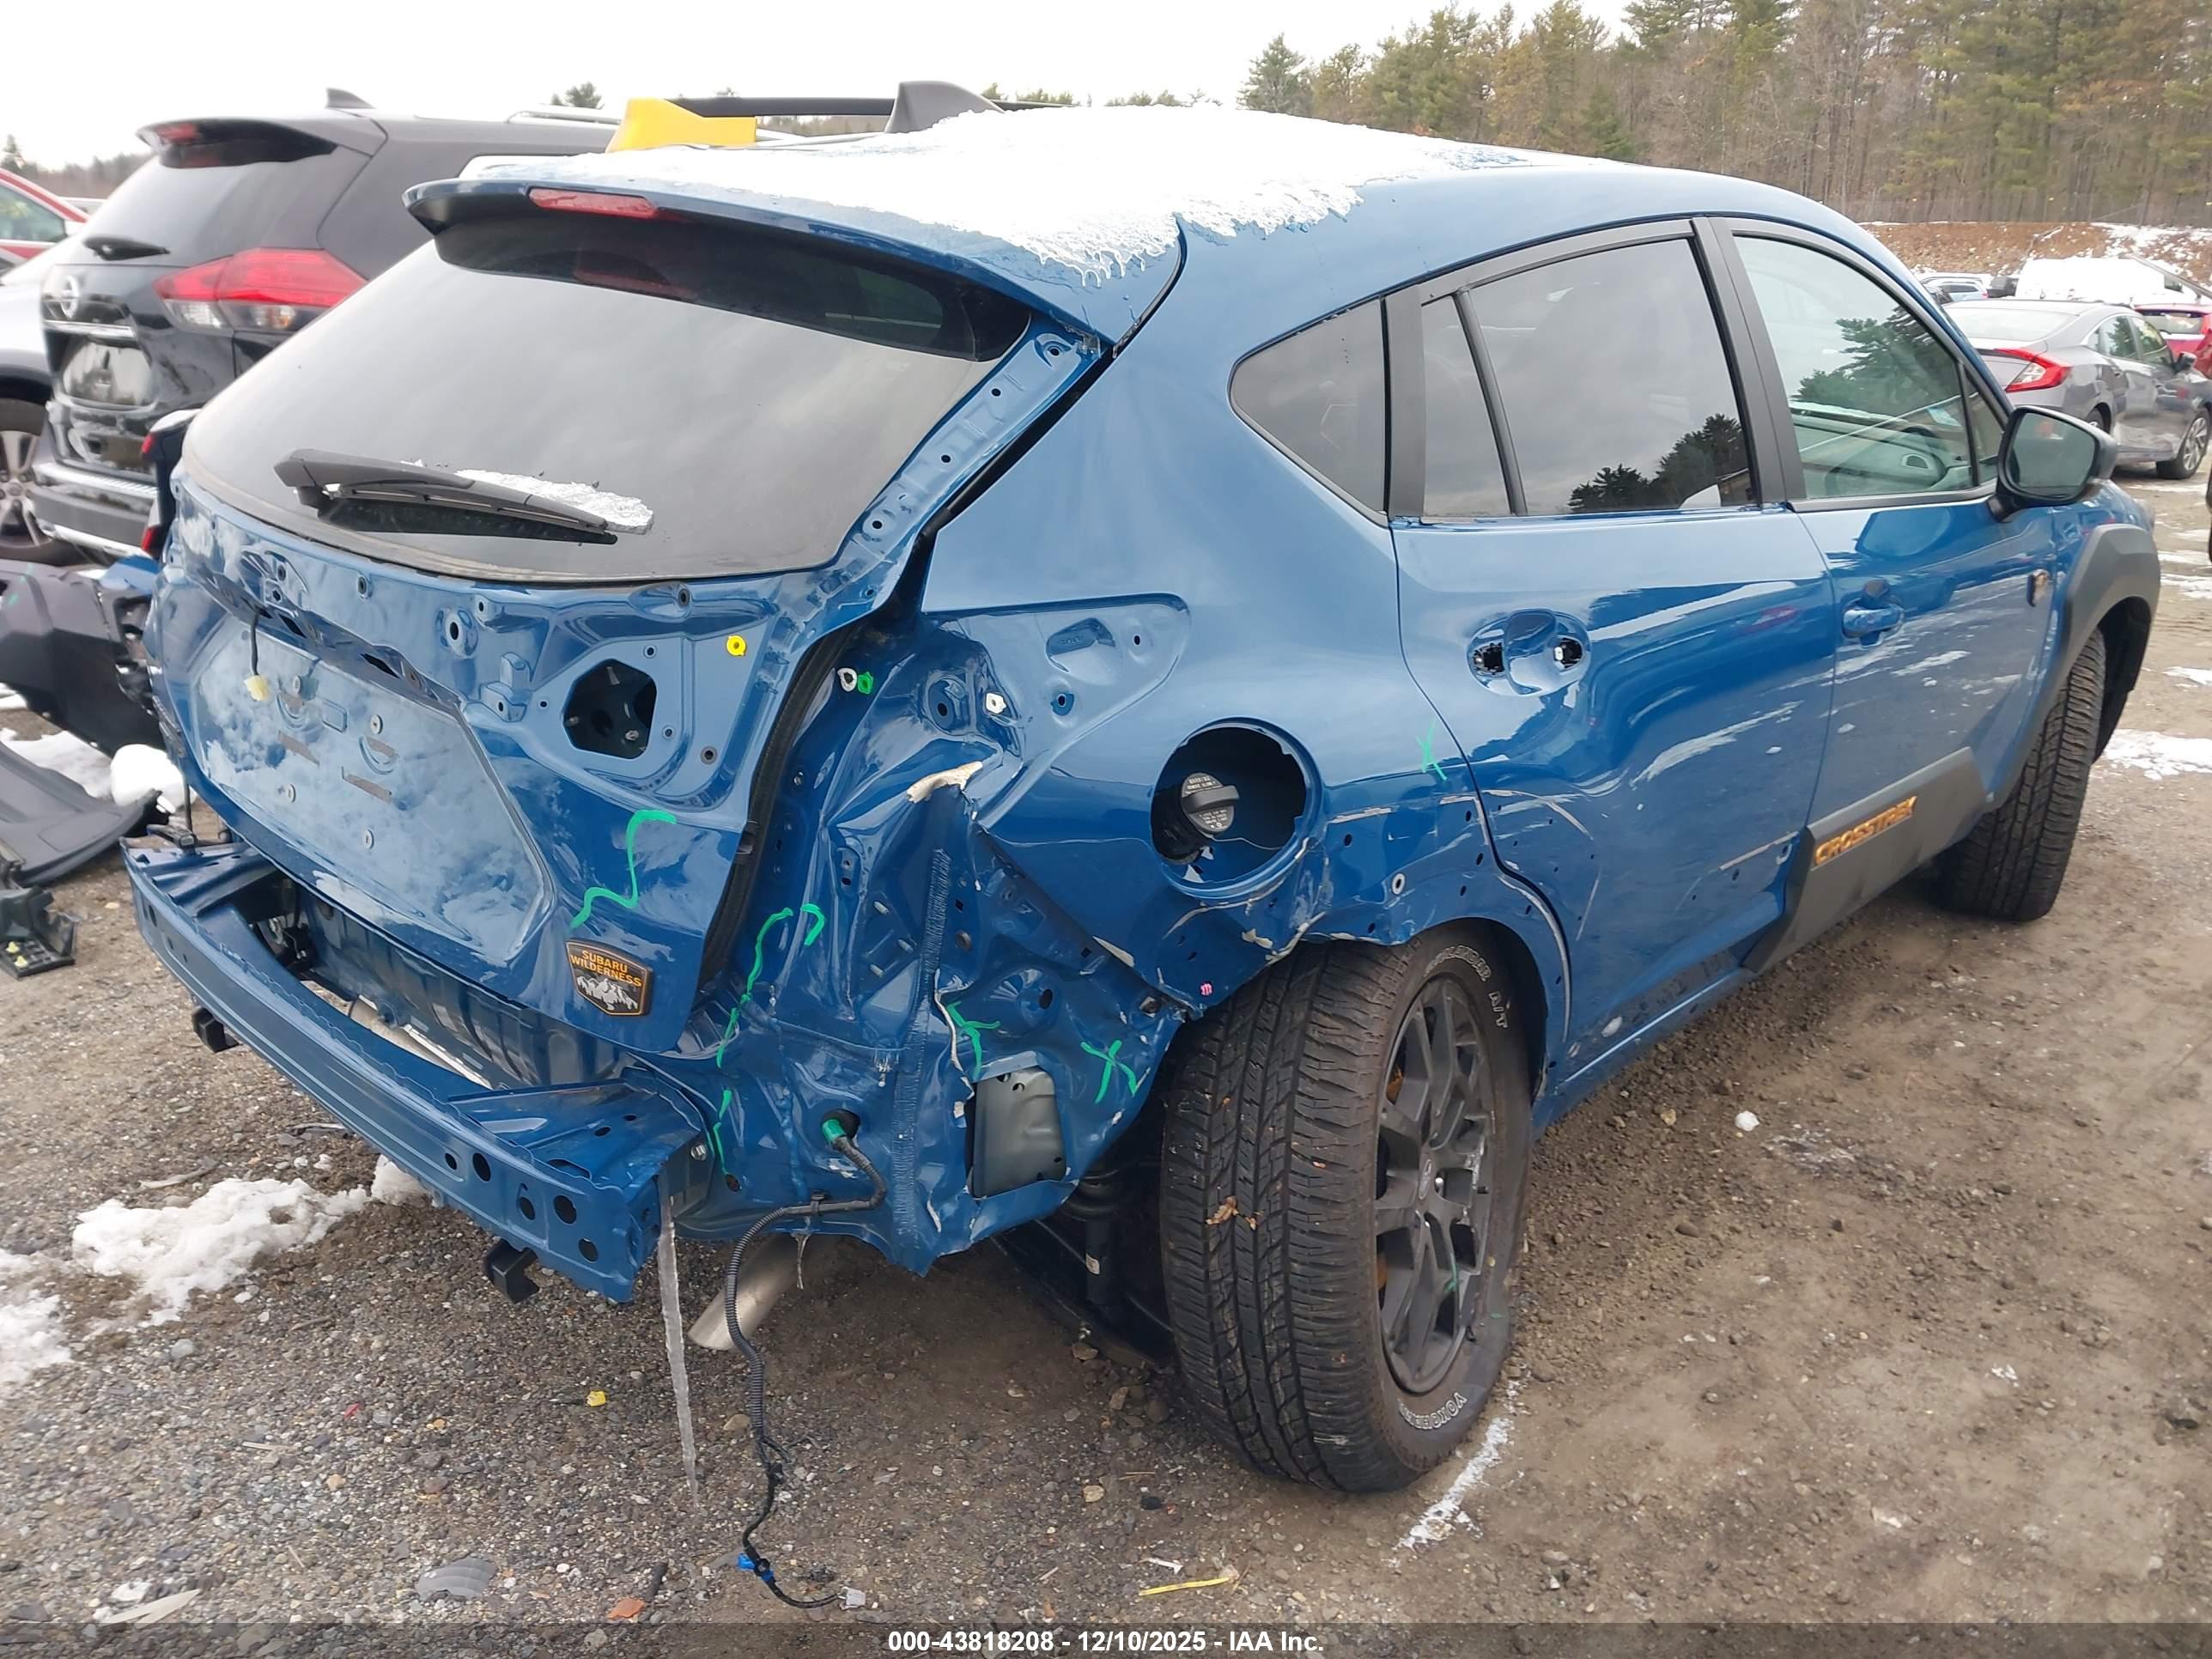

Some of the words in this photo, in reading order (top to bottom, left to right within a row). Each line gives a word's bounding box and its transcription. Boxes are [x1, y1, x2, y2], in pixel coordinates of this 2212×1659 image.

[569, 954, 643, 988] WILDERNESS
[581, 950, 629, 973] SUBARU
[1487, 990, 1509, 1029] A/T
